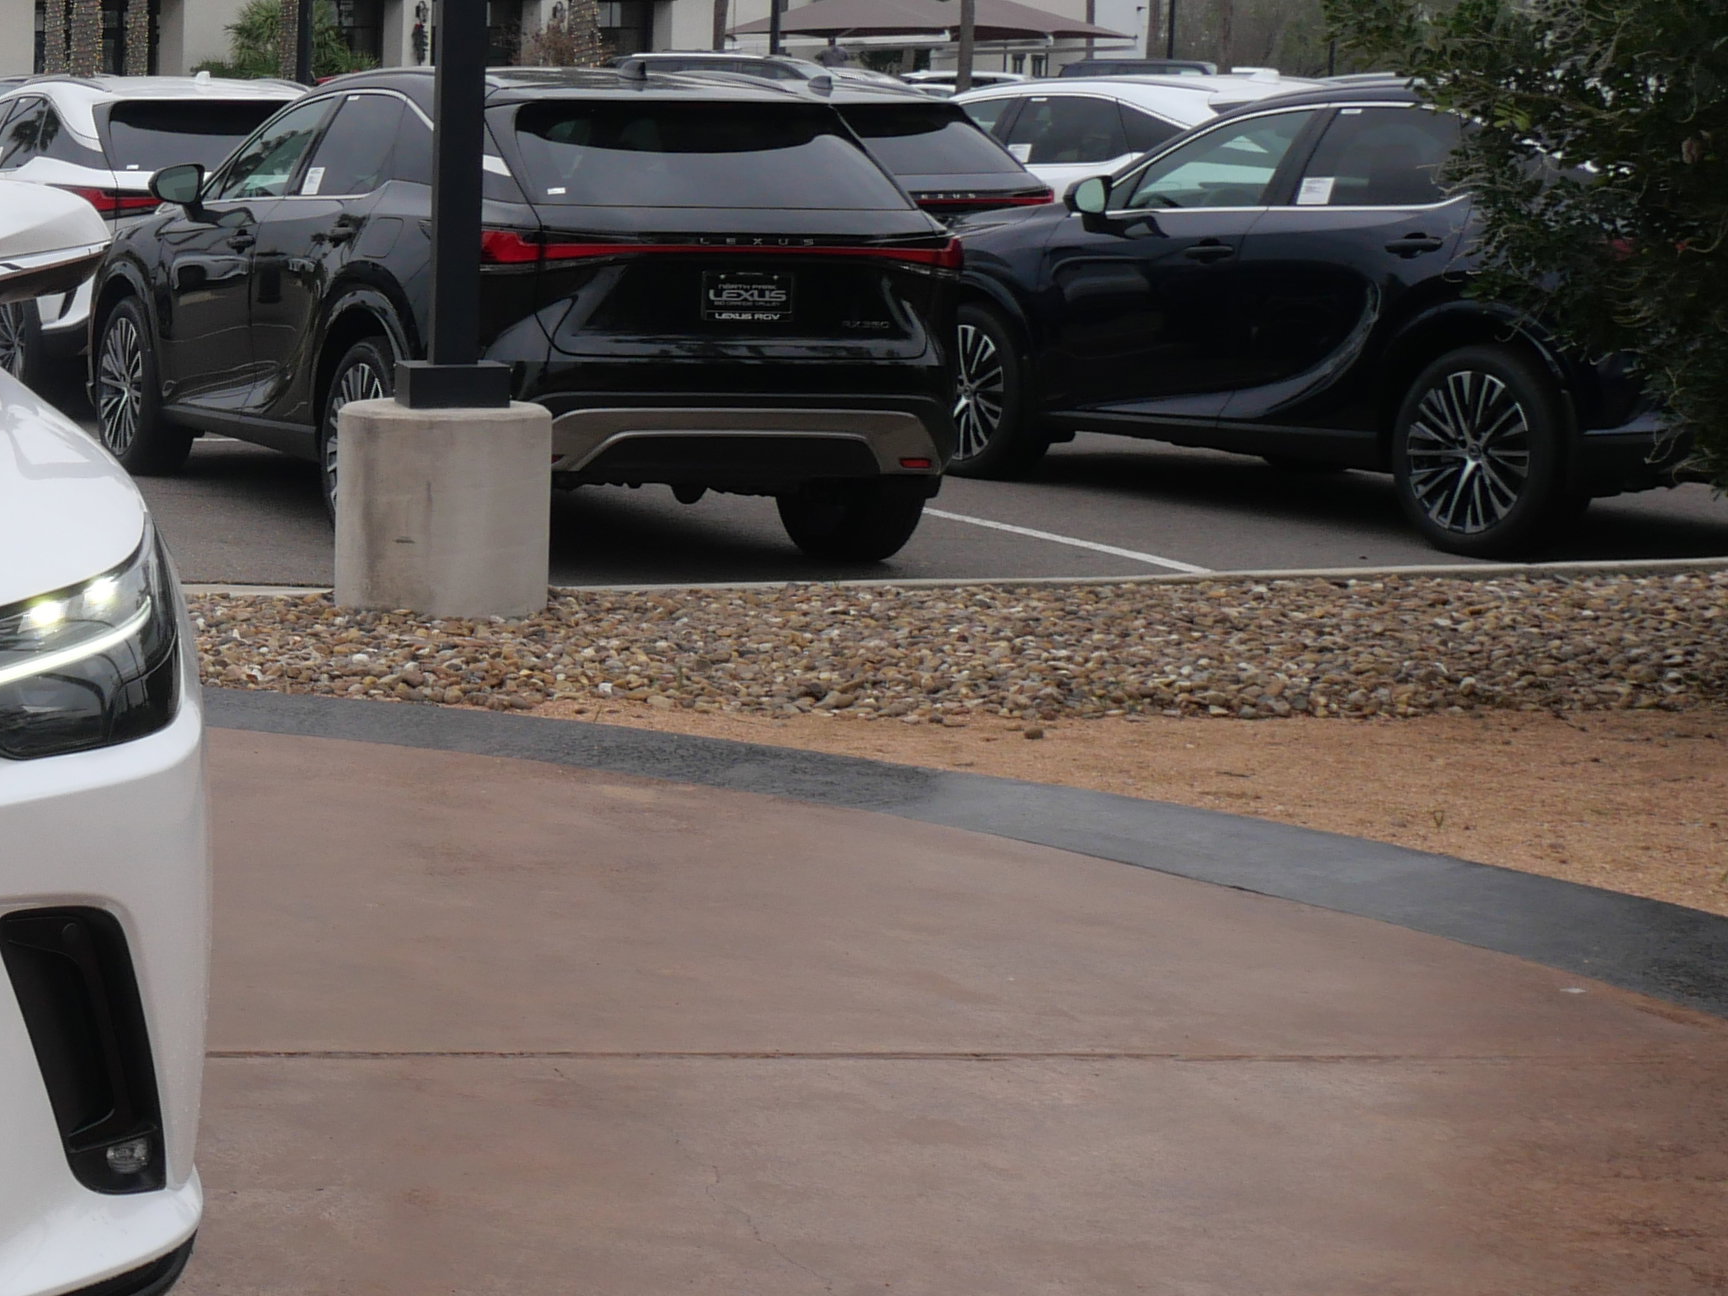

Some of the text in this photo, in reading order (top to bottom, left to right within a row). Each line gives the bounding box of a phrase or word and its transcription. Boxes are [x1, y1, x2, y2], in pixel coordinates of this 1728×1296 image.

[700, 237, 814, 246] LEXUS
[708, 289, 787, 301] LEXUS
[715, 312, 752, 320] LEXUS
